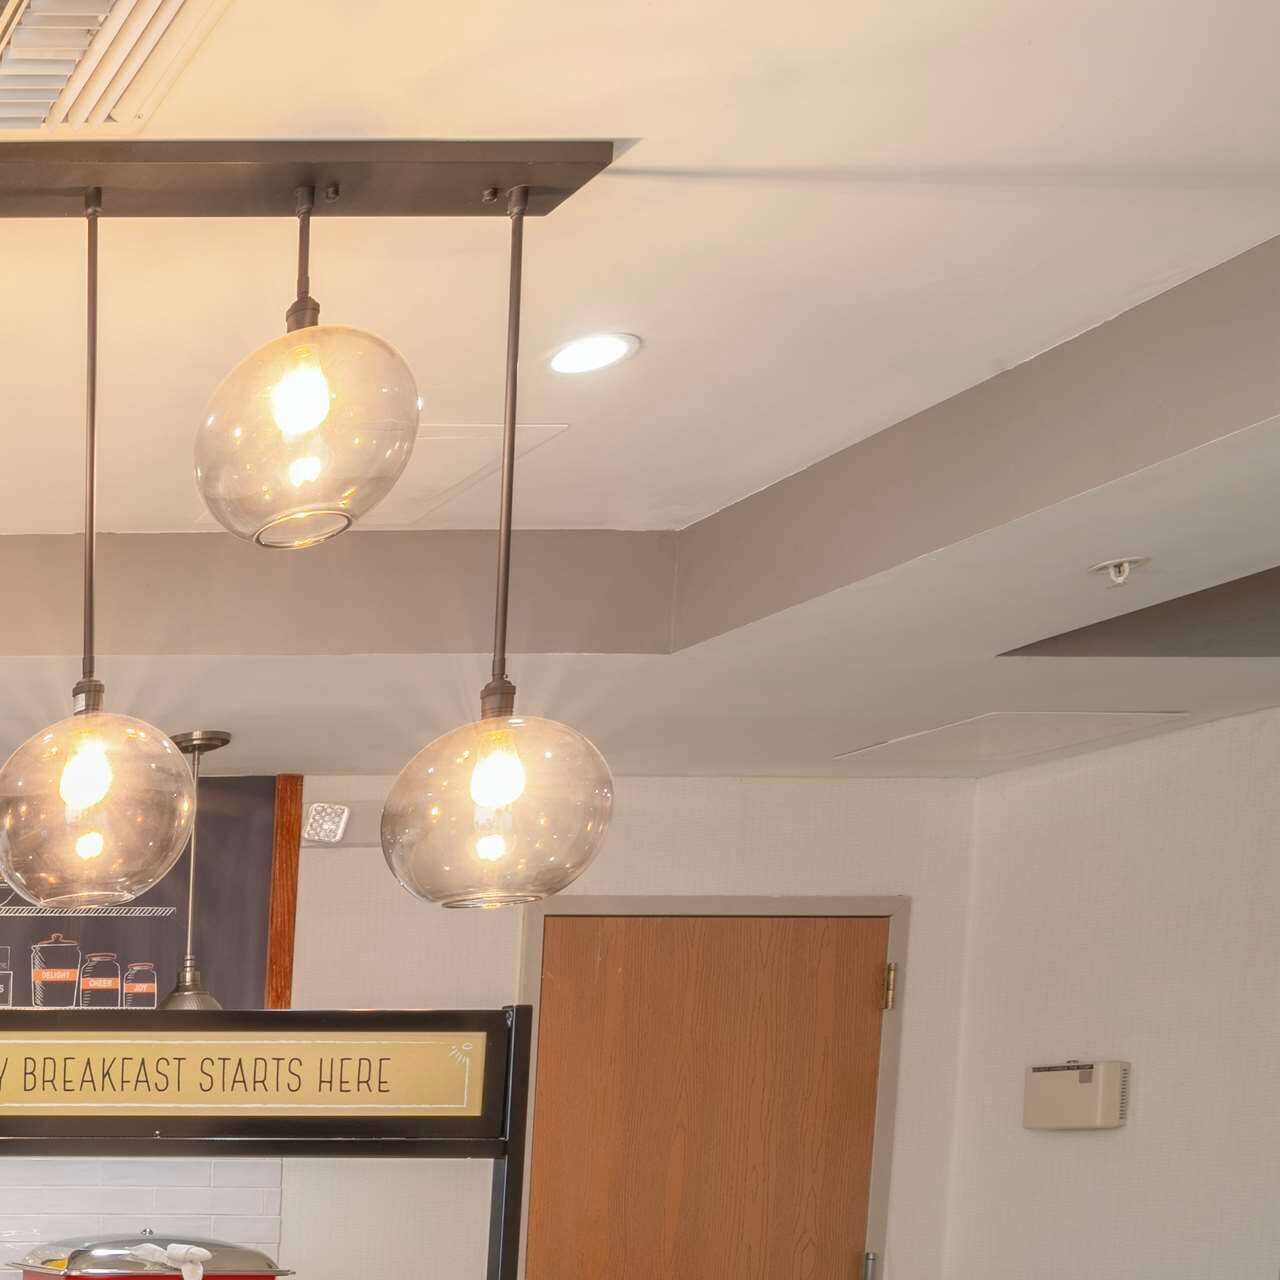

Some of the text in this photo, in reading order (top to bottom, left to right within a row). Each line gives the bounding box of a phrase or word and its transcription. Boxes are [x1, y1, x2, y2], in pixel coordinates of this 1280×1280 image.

[41, 971, 70, 980] DELIGHT
[134, 984, 147, 992] JOY
[23, 1056, 187, 1093] BREAKFAST
[199, 1056, 304, 1093] STARTS
[318, 1056, 392, 1093] HERE
